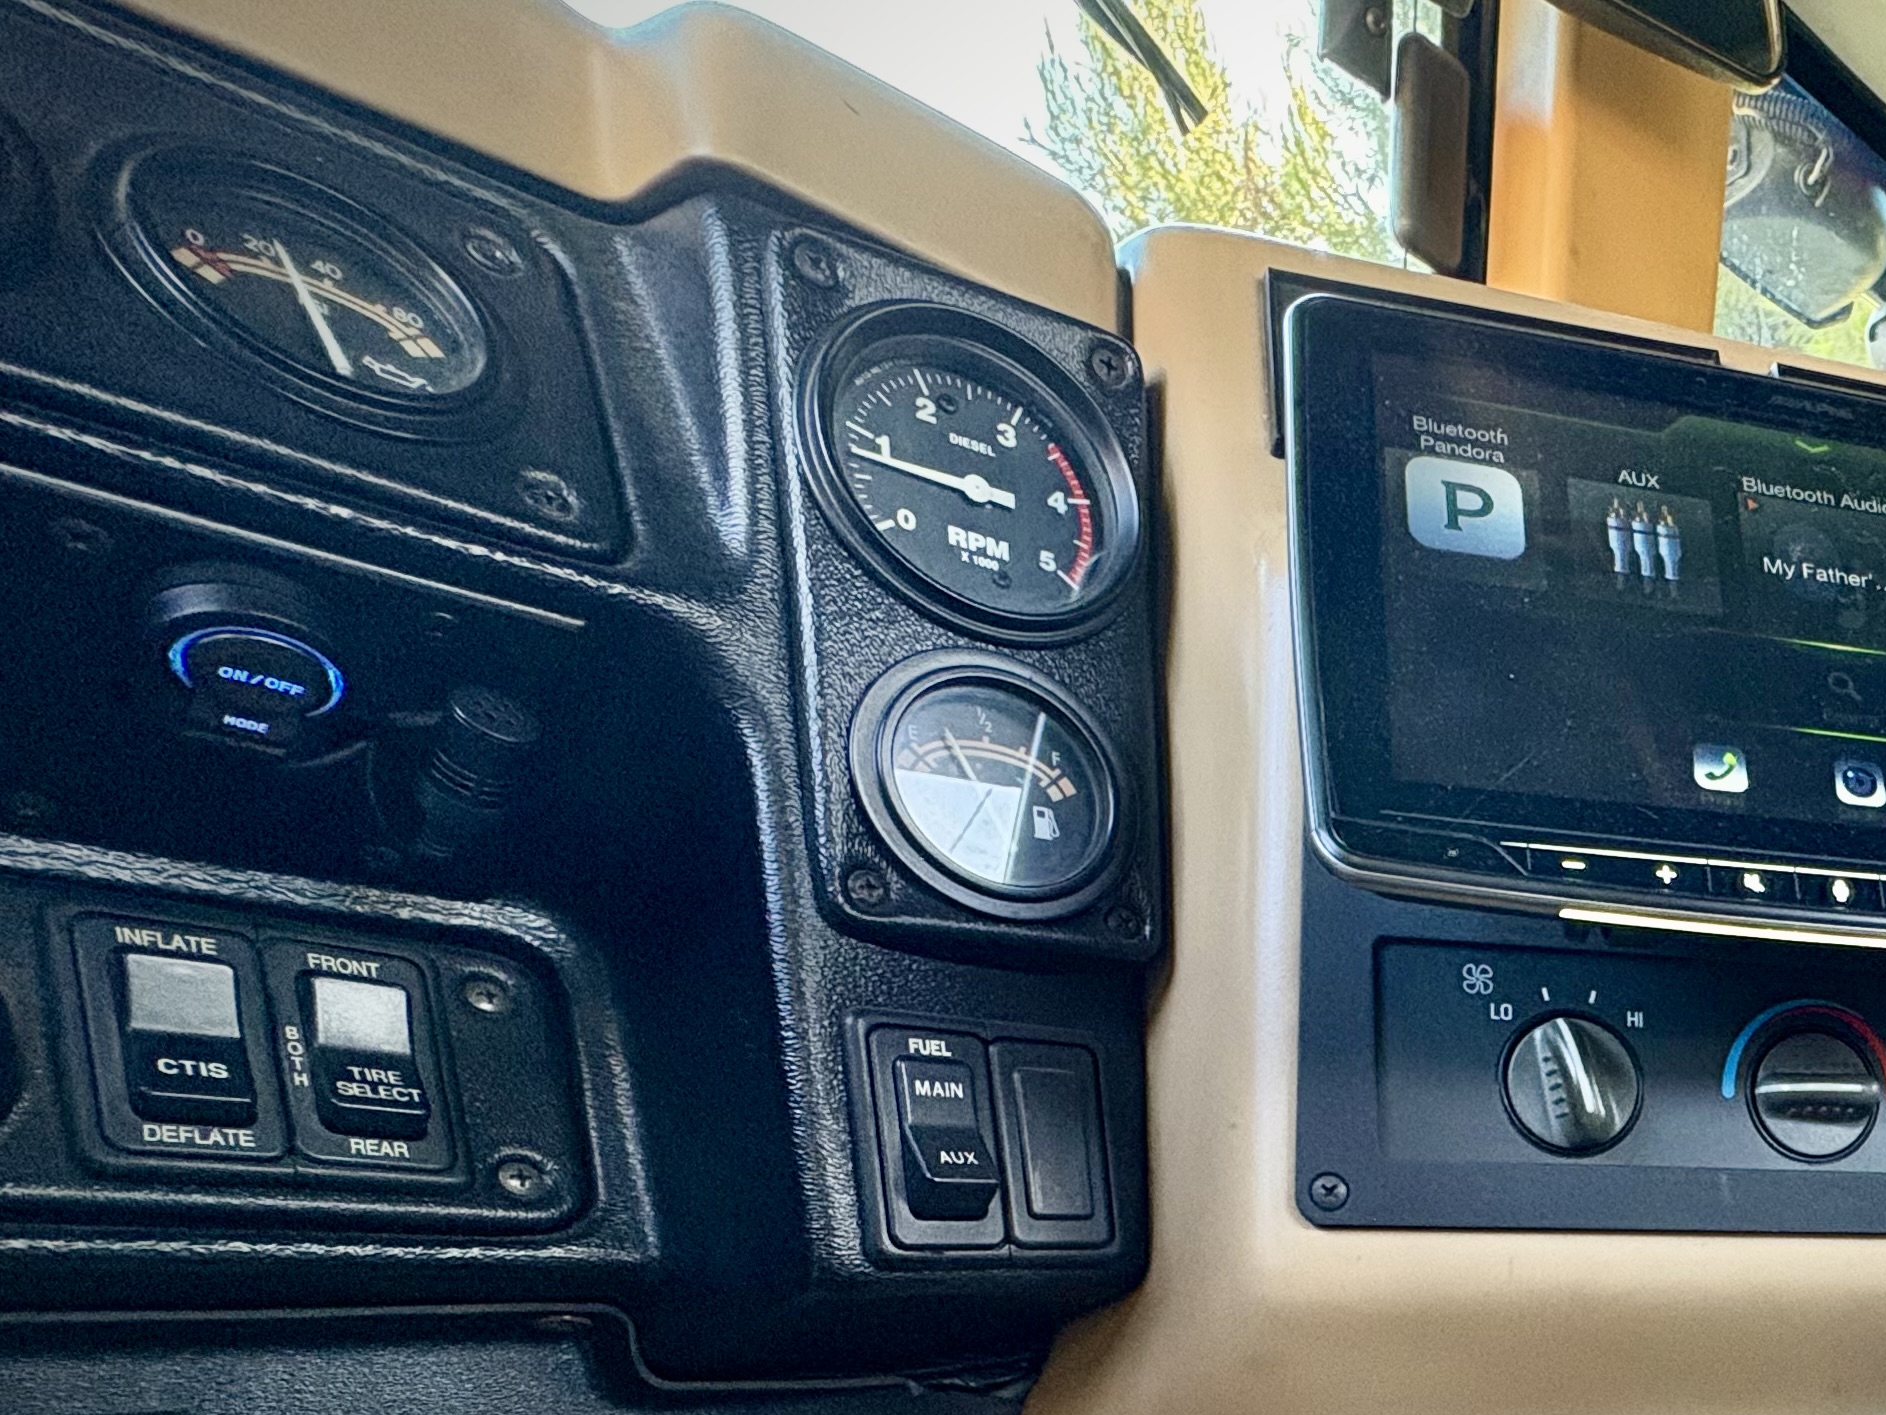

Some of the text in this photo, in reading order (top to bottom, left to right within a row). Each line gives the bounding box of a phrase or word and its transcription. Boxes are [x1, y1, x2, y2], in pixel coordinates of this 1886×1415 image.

[185, 228, 204, 246] 0
[242, 233, 276, 257] 20
[311, 260, 343, 281] 40
[915, 397, 937, 425] 2
[997, 423, 1018, 448] 3
[1412, 414, 1510, 446] Bluetooth
[874, 435, 892, 459] 1
[949, 431, 997, 458] DIESEL
[1419, 434, 1506, 464] Pandora
[1617, 468, 1661, 490] AUX
[1047, 491, 1068, 515] 4
[1741, 475, 1836, 508] Bluetooth
[1440, 479, 1495, 532] P
[896, 508, 917, 531] 0
[947, 524, 1010, 562] RPM
[961, 550, 1000, 572] X 1000
[1040, 549, 1057, 572] 5
[1762, 556, 1797, 585] My
[217, 664, 306, 697] ON/OFF
[222, 713, 270, 735] MODE
[907, 724, 919, 741] E
[1051, 751, 1061, 766] F
[114, 926, 217, 956] INFLATE
[306, 952, 382, 979] FRONT
[1489, 1003, 1514, 1021] LO
[1626, 1010, 1644, 1029] HI
[908, 1038, 952, 1057] FUEL
[156, 1057, 229, 1080] CTIS
[347, 1065, 403, 1086] TIRE
[336, 1080, 423, 1104] SELECT
[914, 1079, 964, 1098] MAIN
[142, 1123, 257, 1148] DEFLATE
[350, 1138, 411, 1160] REAR
[940, 1150, 979, 1165] AUX
